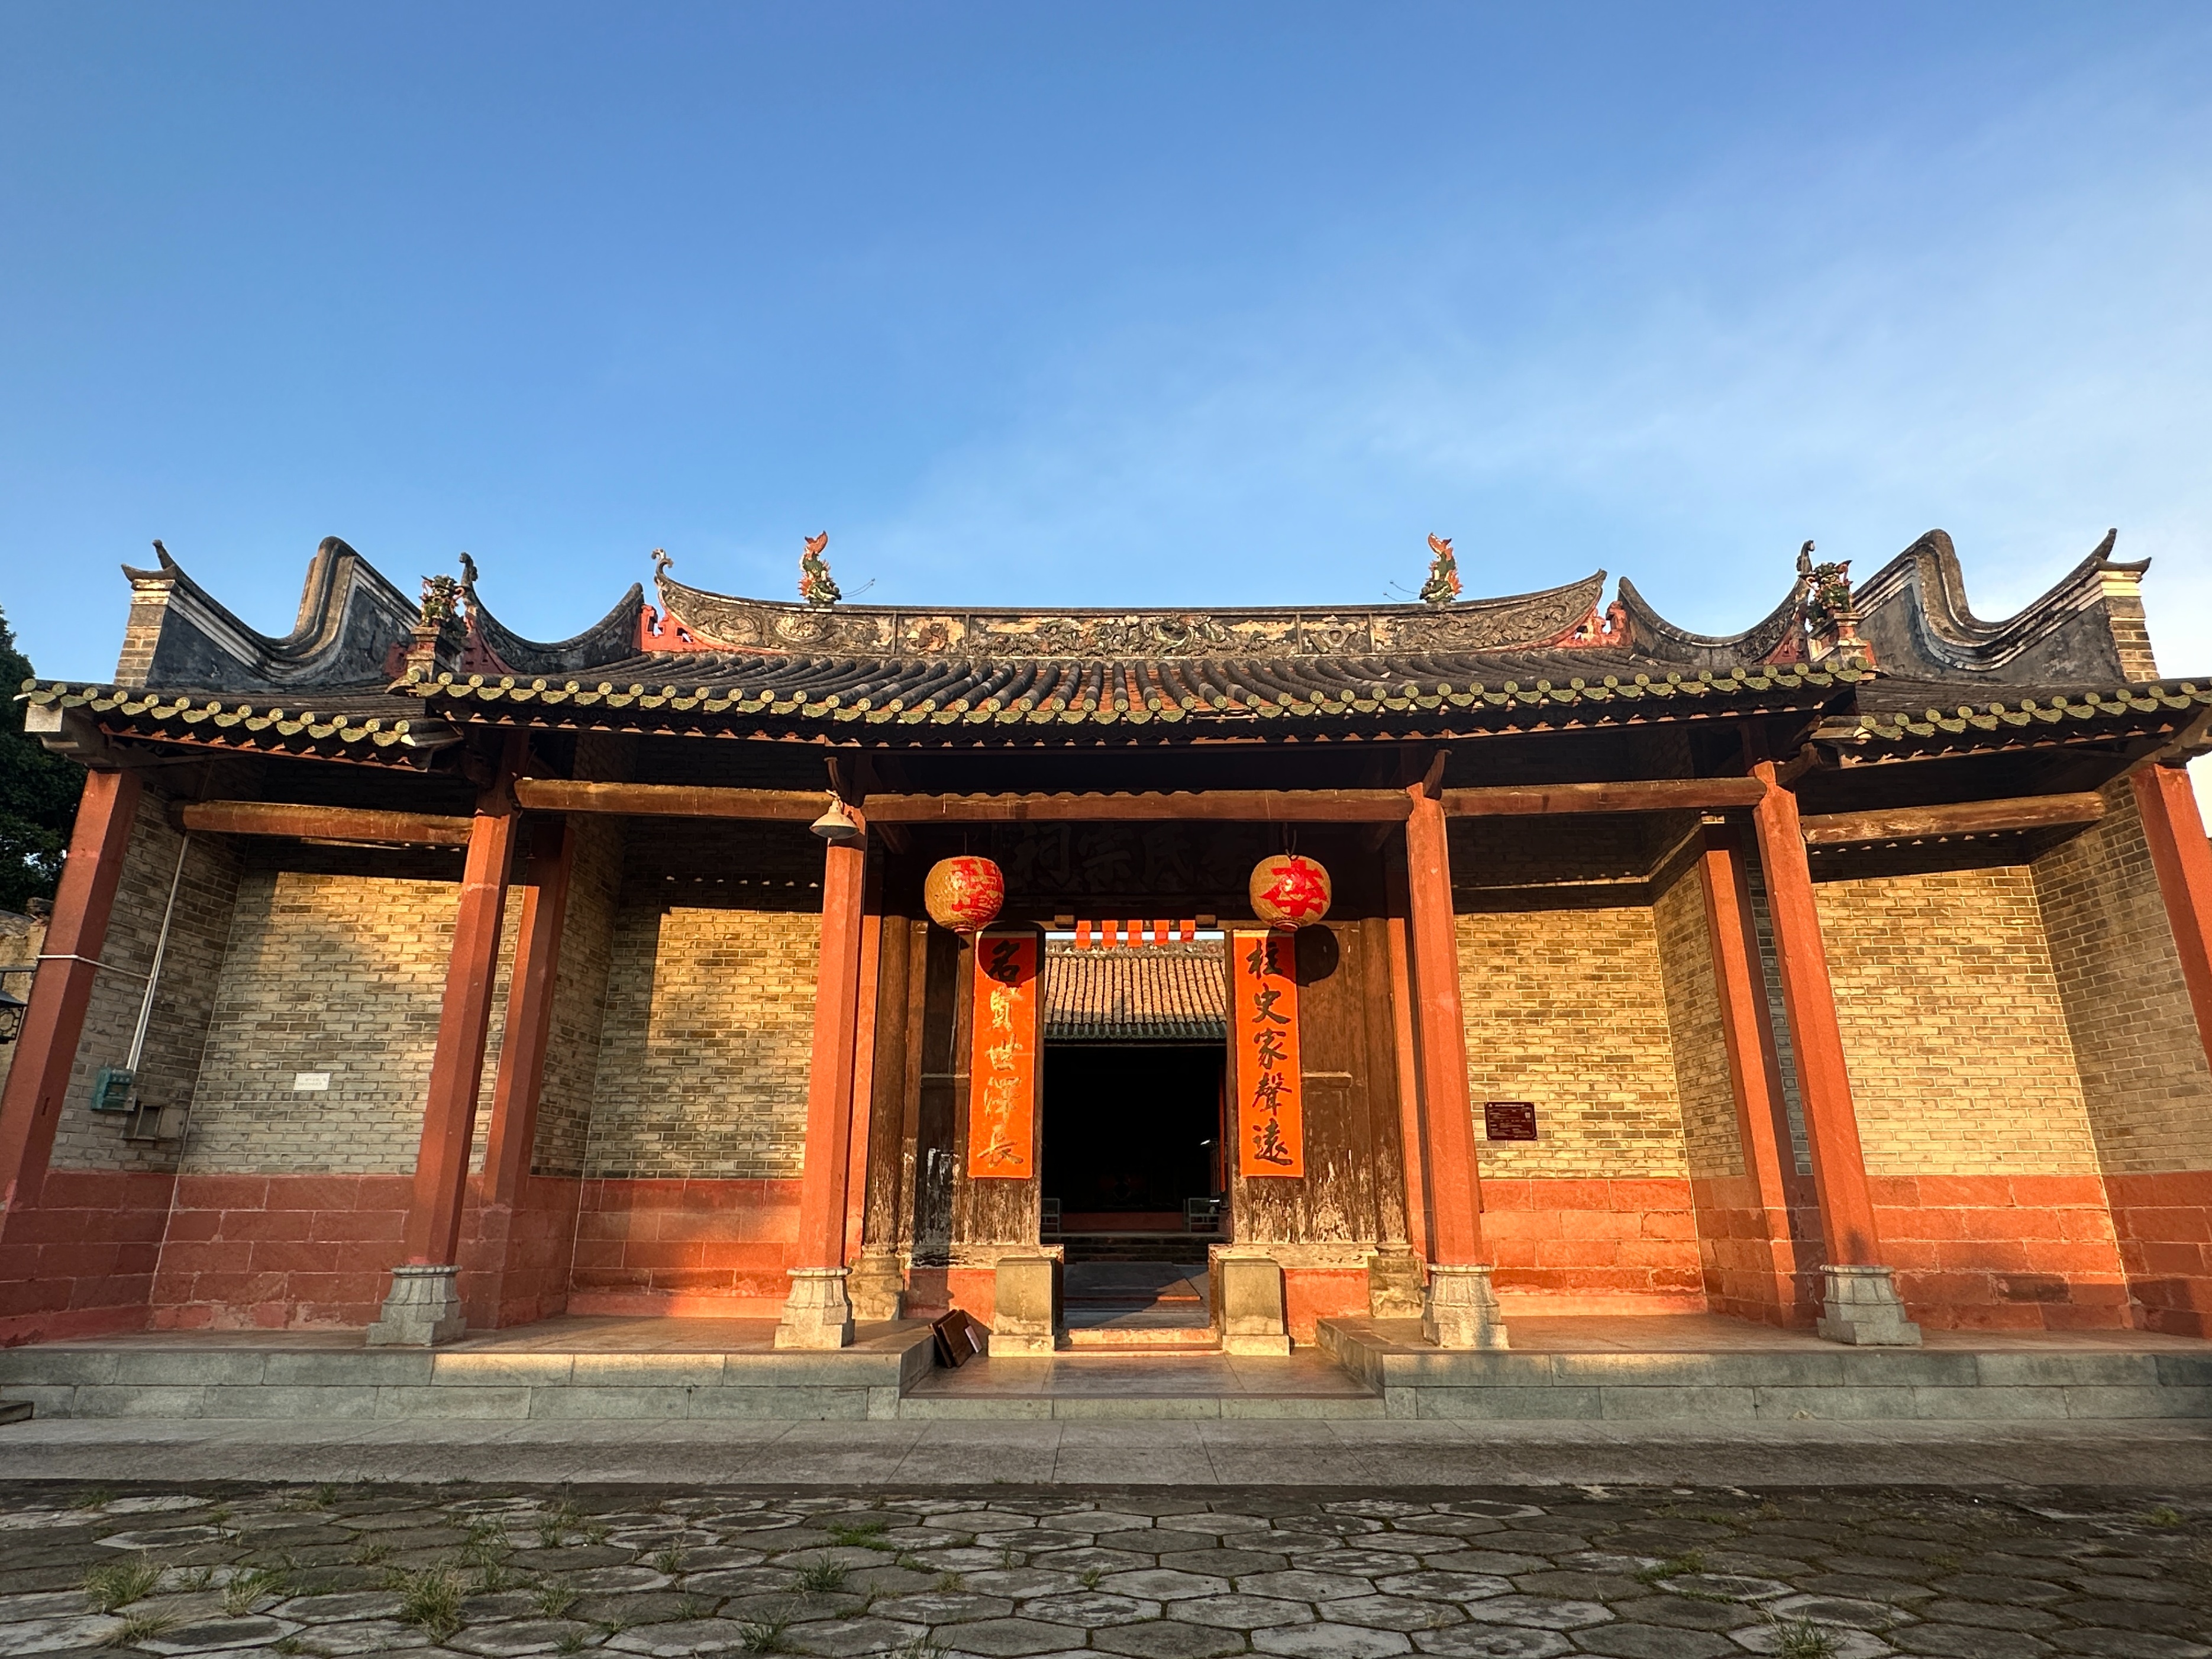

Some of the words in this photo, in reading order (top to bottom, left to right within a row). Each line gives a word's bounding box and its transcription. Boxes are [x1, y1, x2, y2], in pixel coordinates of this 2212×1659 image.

[977, 939, 1024, 1169] 名賢世澤長
[1246, 938, 1293, 1166] 柱史家聲遠
